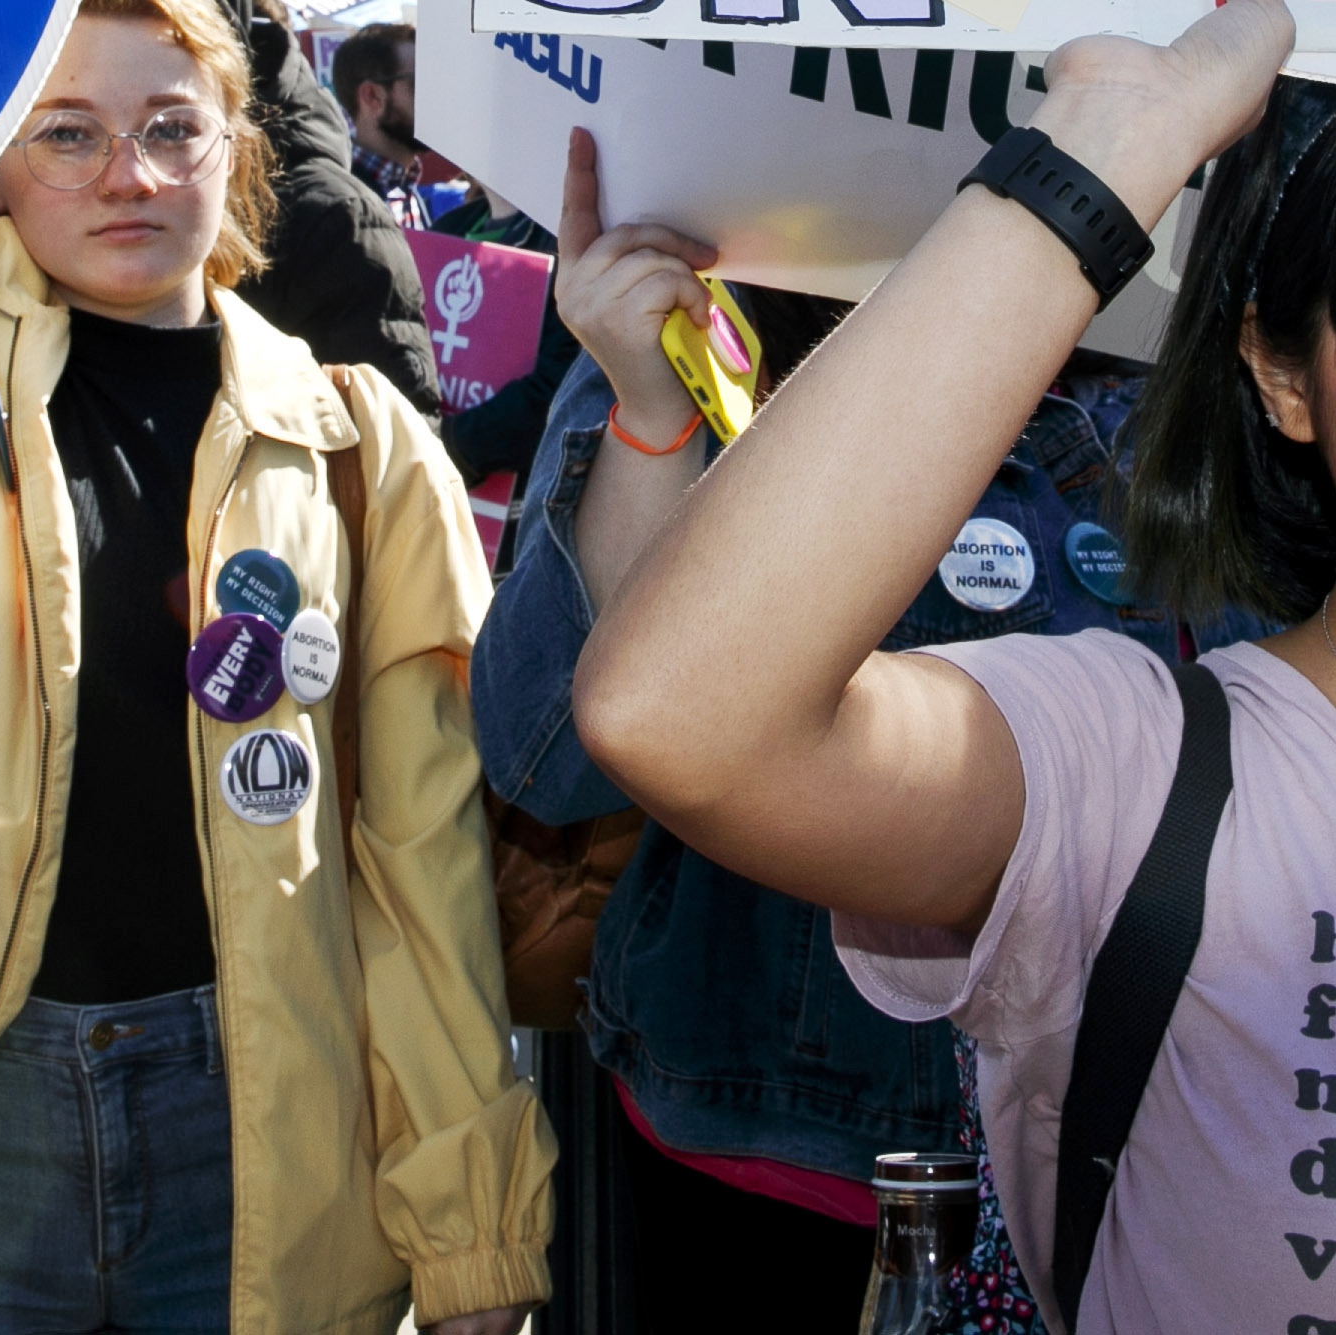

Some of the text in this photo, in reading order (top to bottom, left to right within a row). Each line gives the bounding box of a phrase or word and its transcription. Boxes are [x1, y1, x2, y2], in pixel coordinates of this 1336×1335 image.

[947, 542, 1026, 557] ABORTION
[980, 560, 995, 572] IS
[232, 565, 279, 604] MY RIGHT,
[955, 575, 1022, 590] NORMAL
[225, 576, 286, 624] MY DECISION
[292, 630, 337, 653] ABORTION
[203, 625, 253, 705] EVERY
[308, 652, 318, 665] IS
[226, 634, 275, 713] BODY
[291, 664, 330, 685] NORMAL
[227, 732, 310, 795] NOW
[235, 791, 304, 804] NATIONAL
[897, 1223, 937, 1236] Mocha
